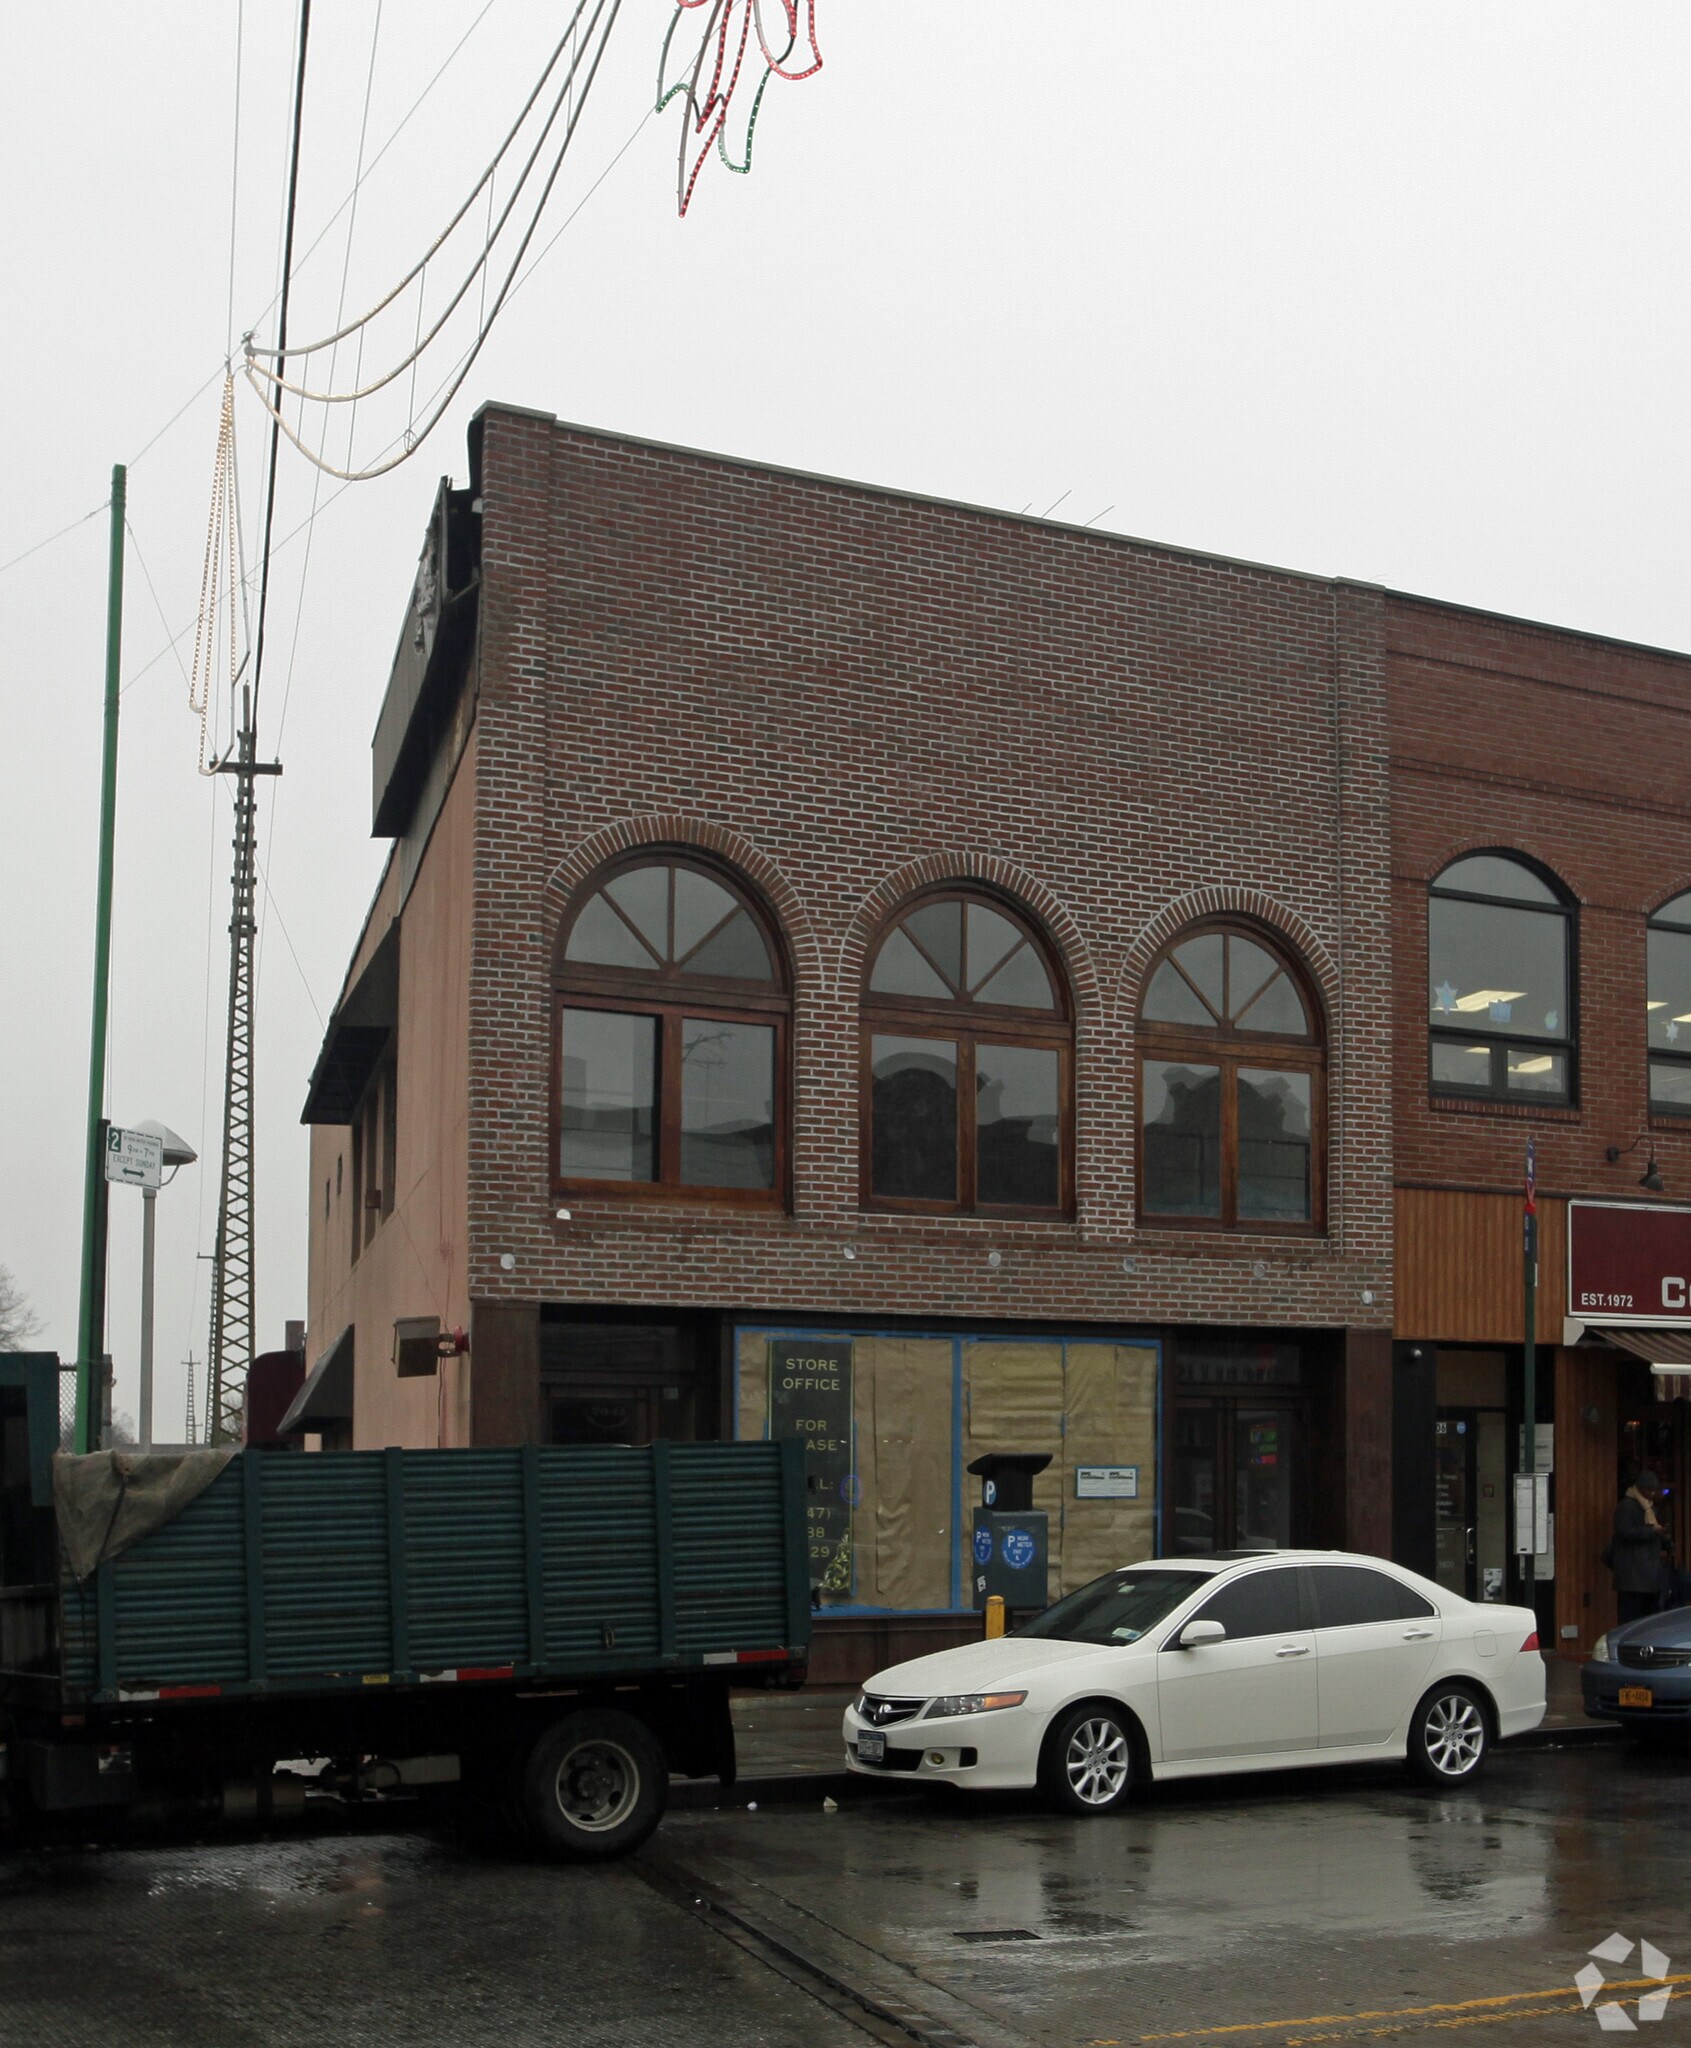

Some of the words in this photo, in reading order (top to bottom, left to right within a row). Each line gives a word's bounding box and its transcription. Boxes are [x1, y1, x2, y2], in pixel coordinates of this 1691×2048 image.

[111, 1131, 119, 1150] 2
[1661, 1276, 1691, 1308] C
[1581, 1292, 1633, 1307] EST.1972
[785, 1358, 838, 1371] STORE
[782, 1377, 841, 1391] OFFICE
[796, 1419, 827, 1431] FOR
[806, 1439, 837, 1451] ASE
[986, 1480, 995, 1504] P
[807, 1507, 831, 1520] 47)
[1007, 1535, 1016, 1547] P
[810, 1546, 830, 1557] 29
